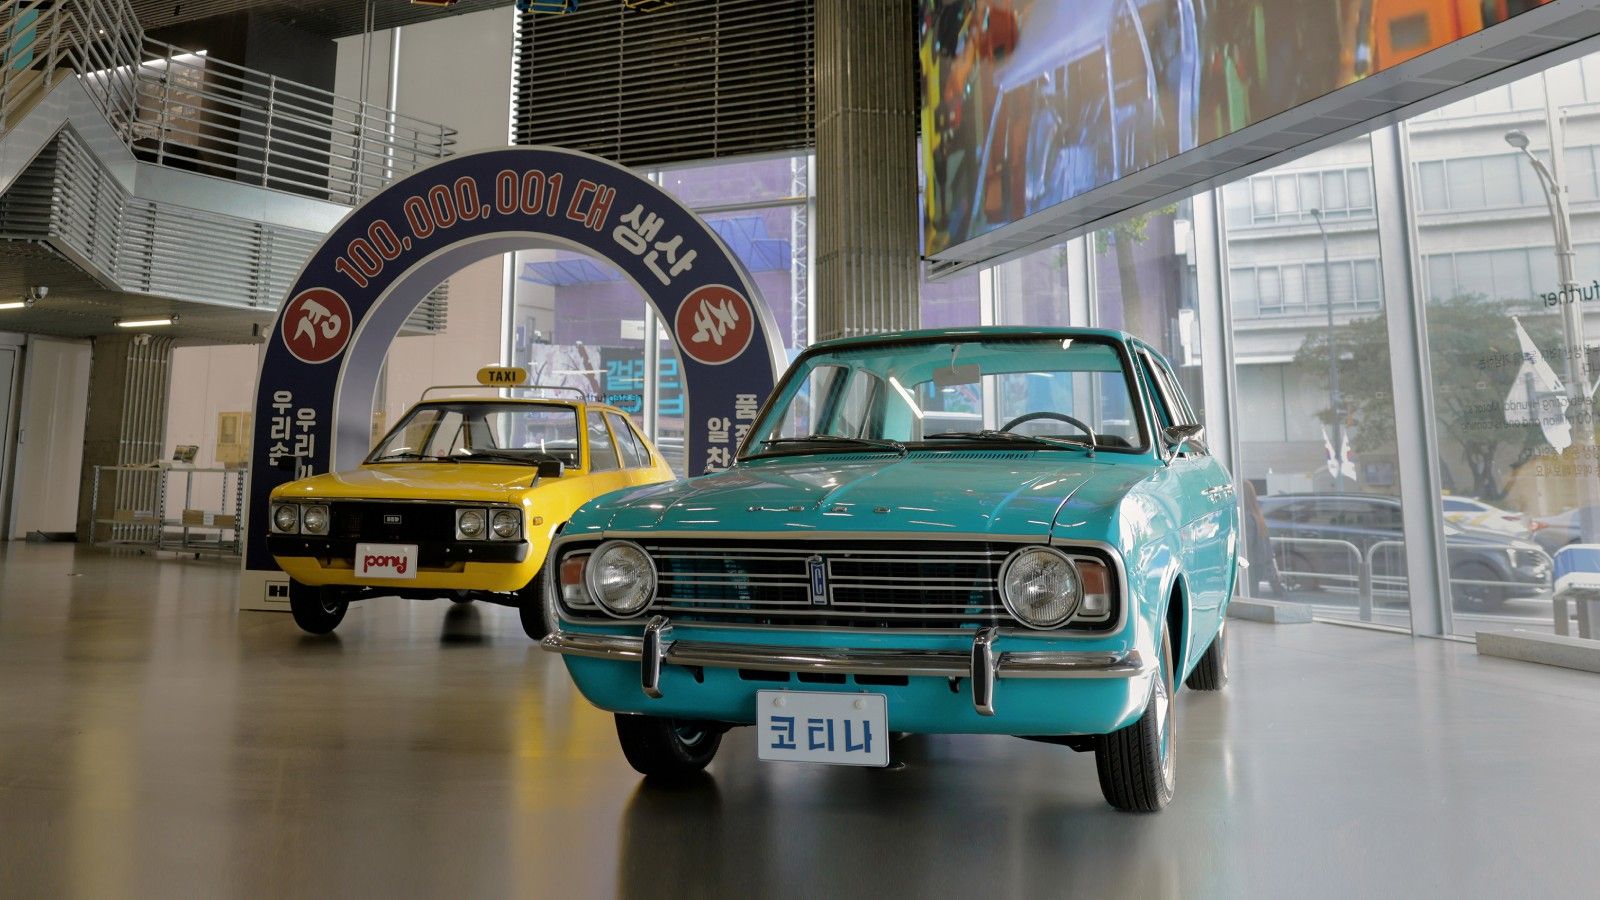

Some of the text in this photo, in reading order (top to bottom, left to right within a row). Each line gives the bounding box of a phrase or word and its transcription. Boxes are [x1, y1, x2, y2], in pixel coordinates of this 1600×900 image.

[335, 169, 697, 288] 100,000,001 대 생산
[293, 298, 341, 348] 경
[691, 298, 739, 346] 축
[488, 370, 516, 382] TAXI
[363, 555, 407, 574] pony
[770, 715, 873, 754] 코티나
